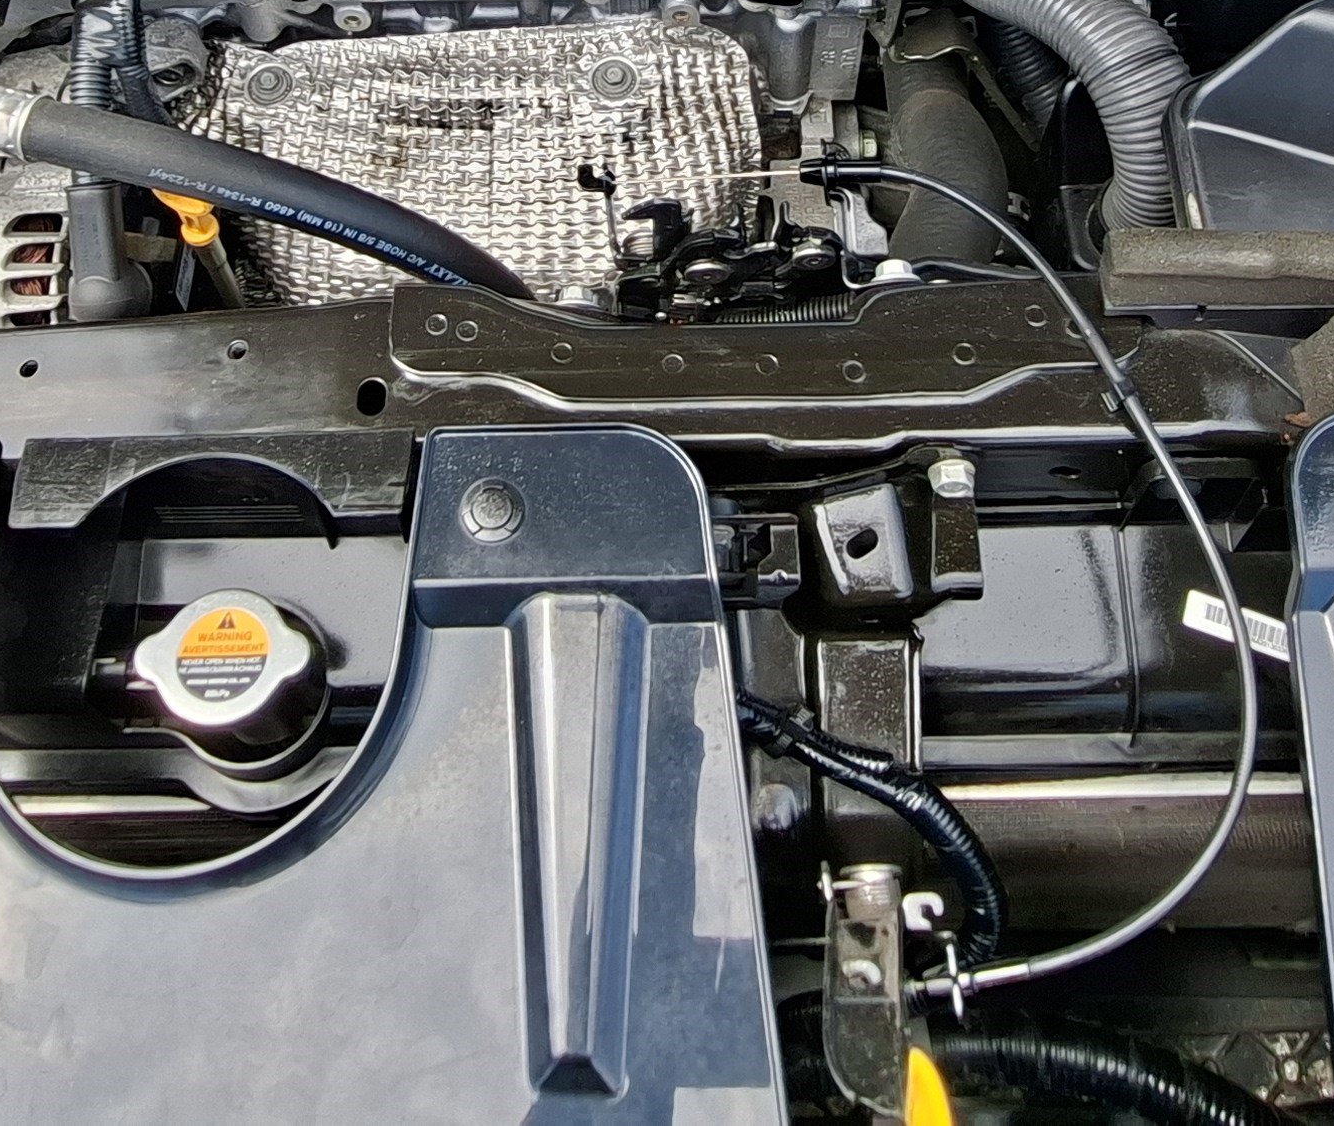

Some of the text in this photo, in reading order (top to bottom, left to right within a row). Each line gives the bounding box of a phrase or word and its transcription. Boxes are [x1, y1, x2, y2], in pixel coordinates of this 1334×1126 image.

[296, 209, 323, 227] MM)
[324, 220, 344, 234] (16
[343, 227, 358, 239] IN
[357, 232, 376, 245] 5/8
[374, 239, 408, 259] HOSE
[406, 253, 427, 267] A/C
[199, 632, 252, 641] WARNING
[183, 643, 265, 653] AVERTISSEMENT
